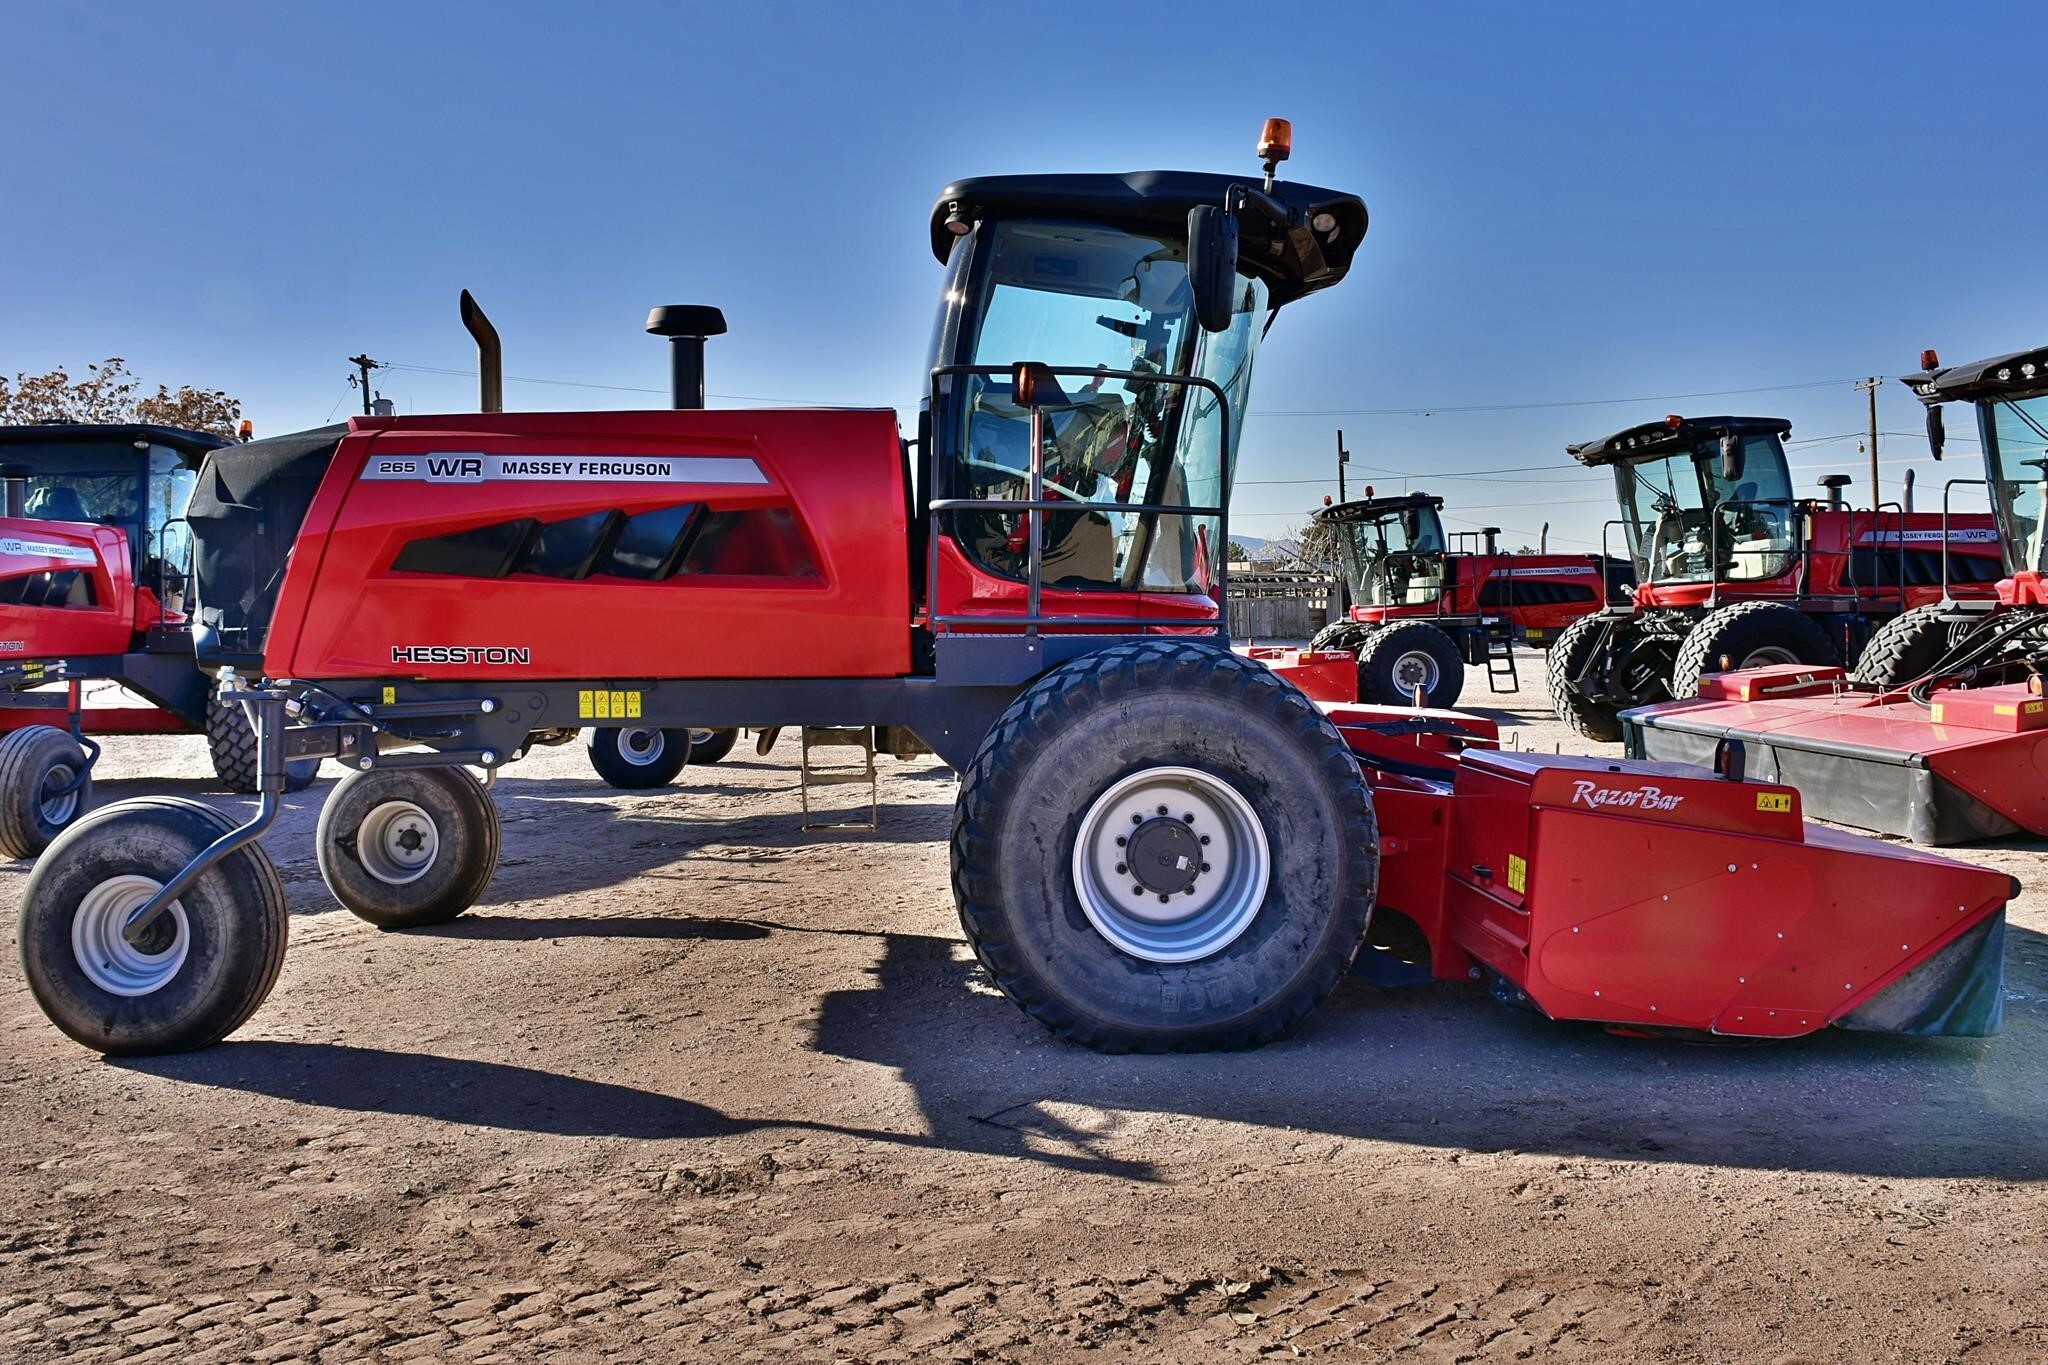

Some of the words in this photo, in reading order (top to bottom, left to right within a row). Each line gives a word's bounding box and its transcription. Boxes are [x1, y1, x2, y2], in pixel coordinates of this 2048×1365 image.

[379, 461, 416, 473] 265
[426, 458, 482, 477] WR
[502, 462, 573, 475] MASSEY
[579, 462, 671, 476] FERGUSON
[1966, 531, 1987, 539] WR
[4, 542, 22, 552] WR
[391, 645, 530, 664] HESSTON
[1572, 780, 1685, 811] RazorBar
